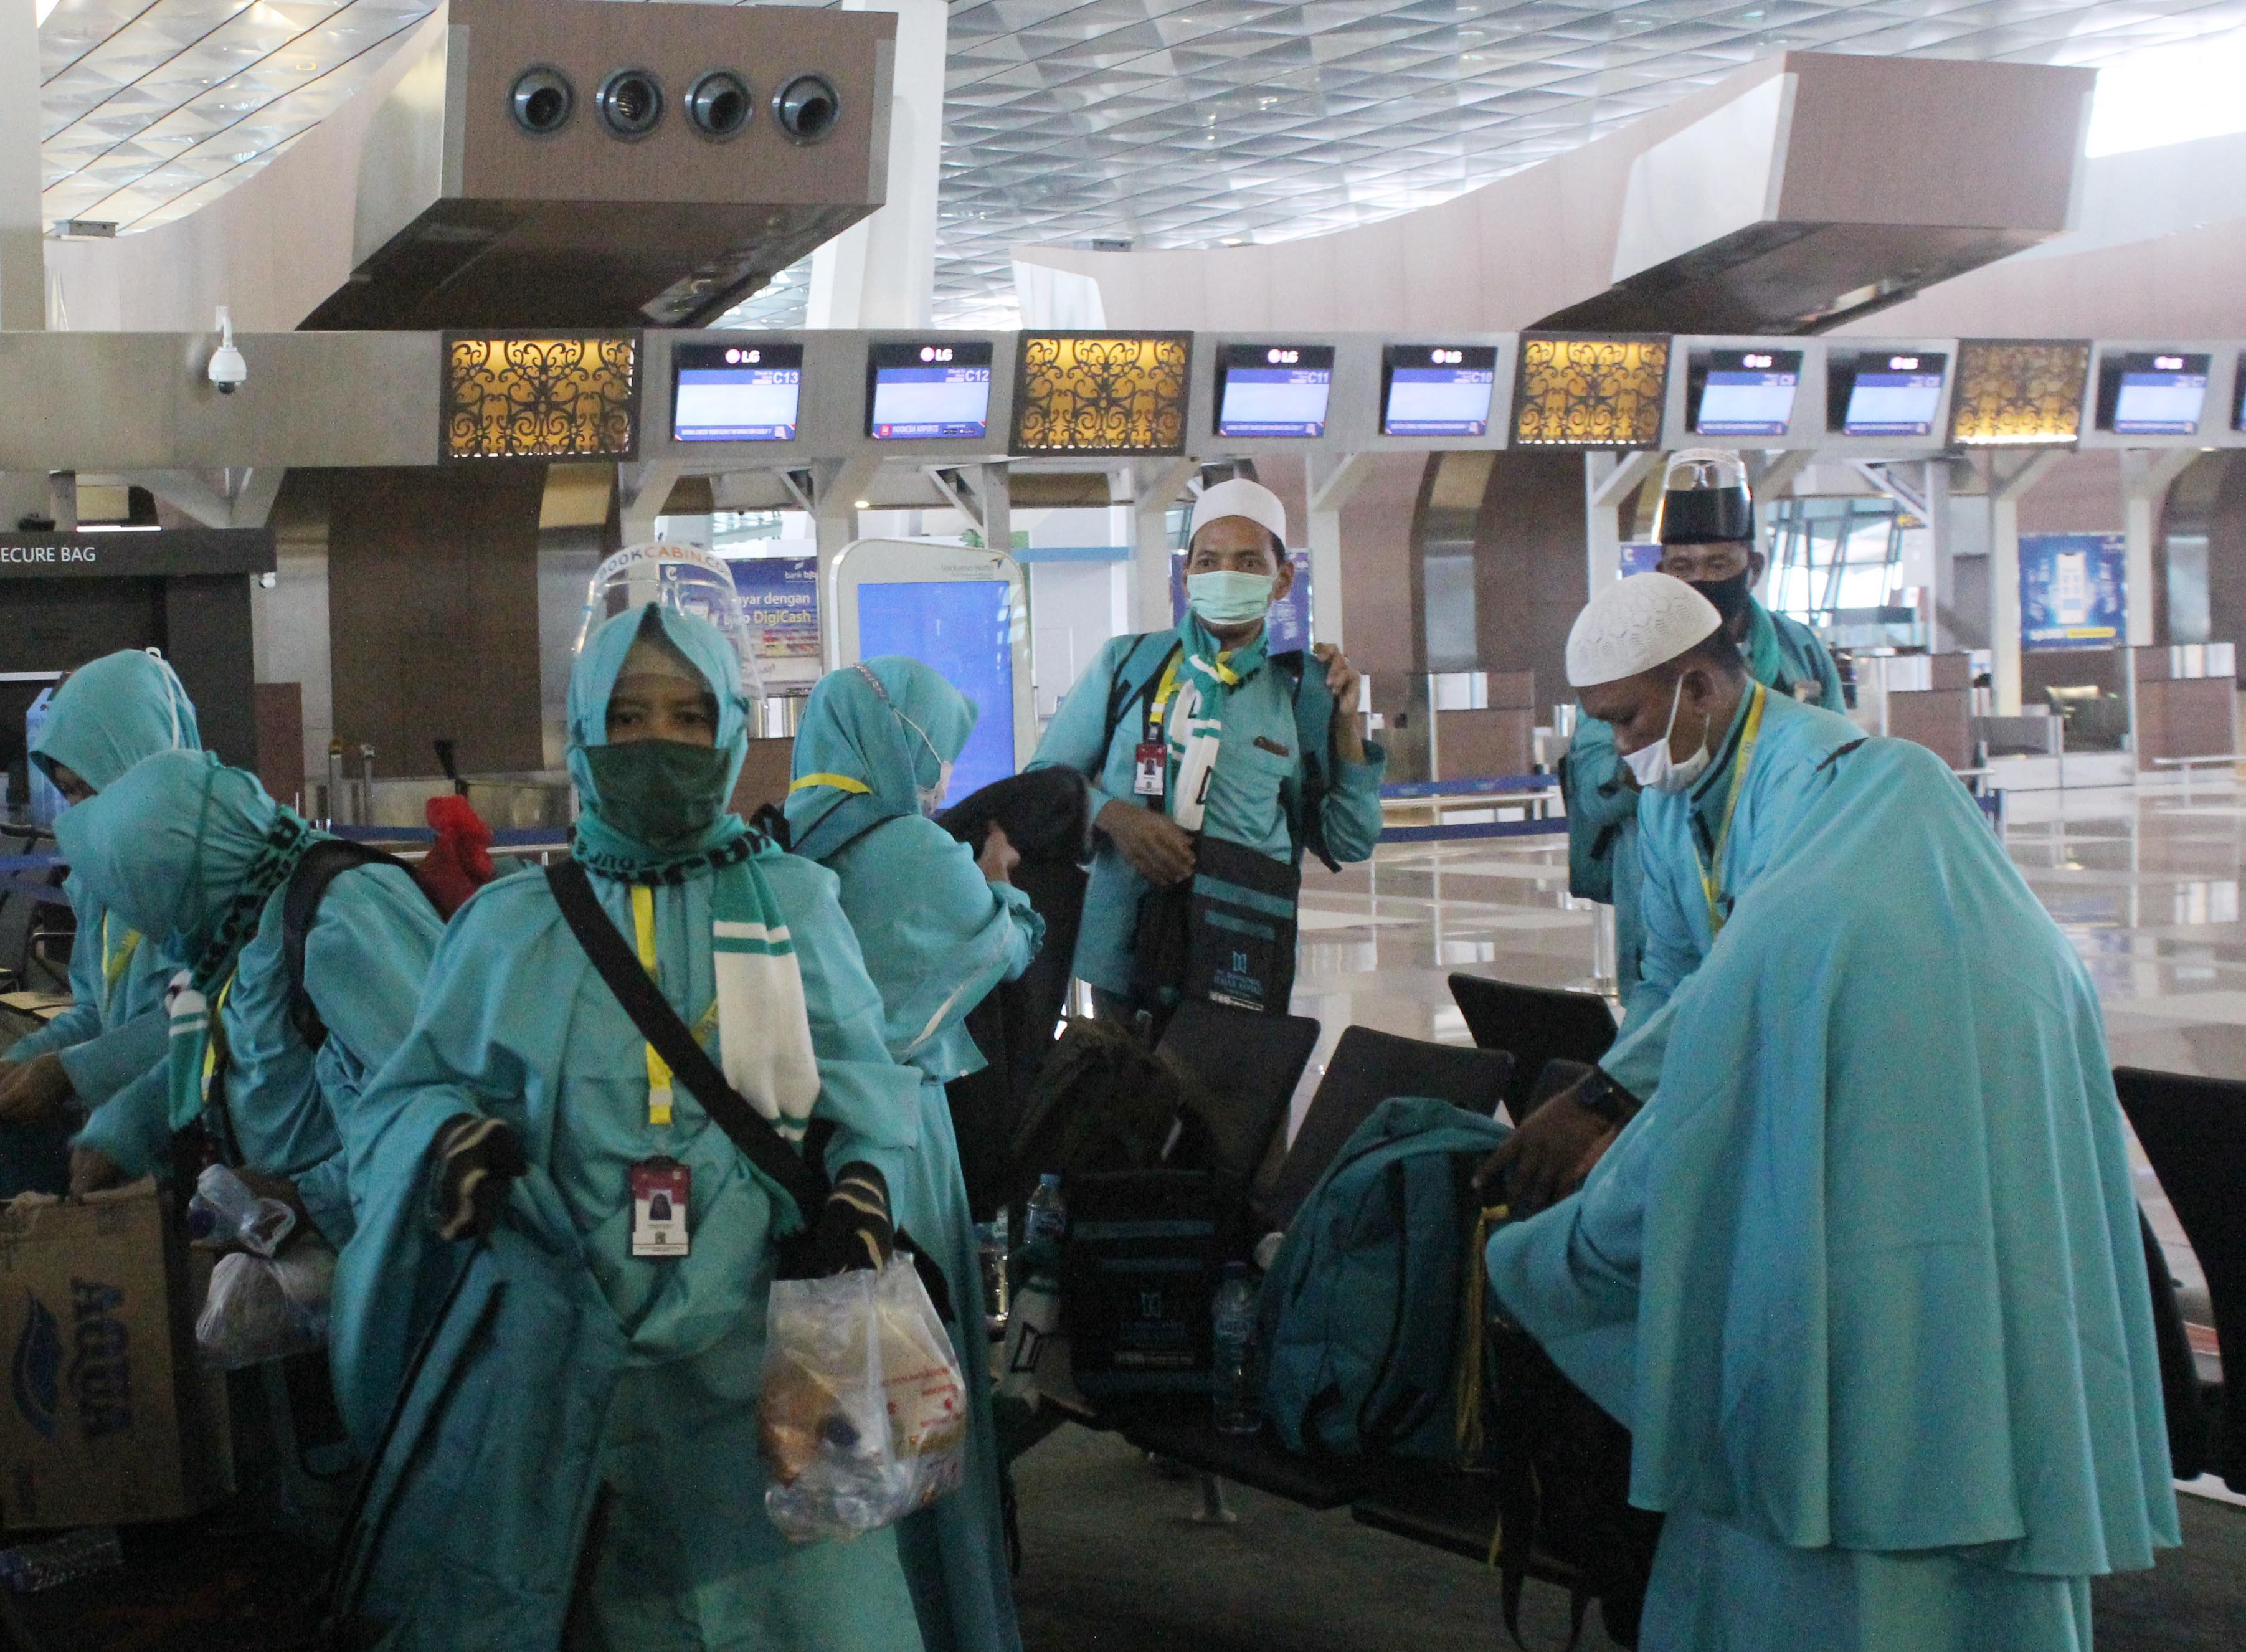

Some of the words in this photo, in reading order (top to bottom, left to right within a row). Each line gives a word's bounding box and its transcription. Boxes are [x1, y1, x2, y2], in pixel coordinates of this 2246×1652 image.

[741, 349, 761, 363] LG
[935, 348, 954, 361] LG
[1281, 350, 1299, 363] LG
[1444, 350, 1462, 364] LG
[772, 371, 799, 384] C13
[965, 369, 990, 382] C12
[1307, 371, 1329, 384] C11
[1471, 371, 1493, 384] C10
[60, 546, 96, 562] BAG
[764, 592, 810, 607] dengan
[70, 1278, 133, 1436] AQUA
